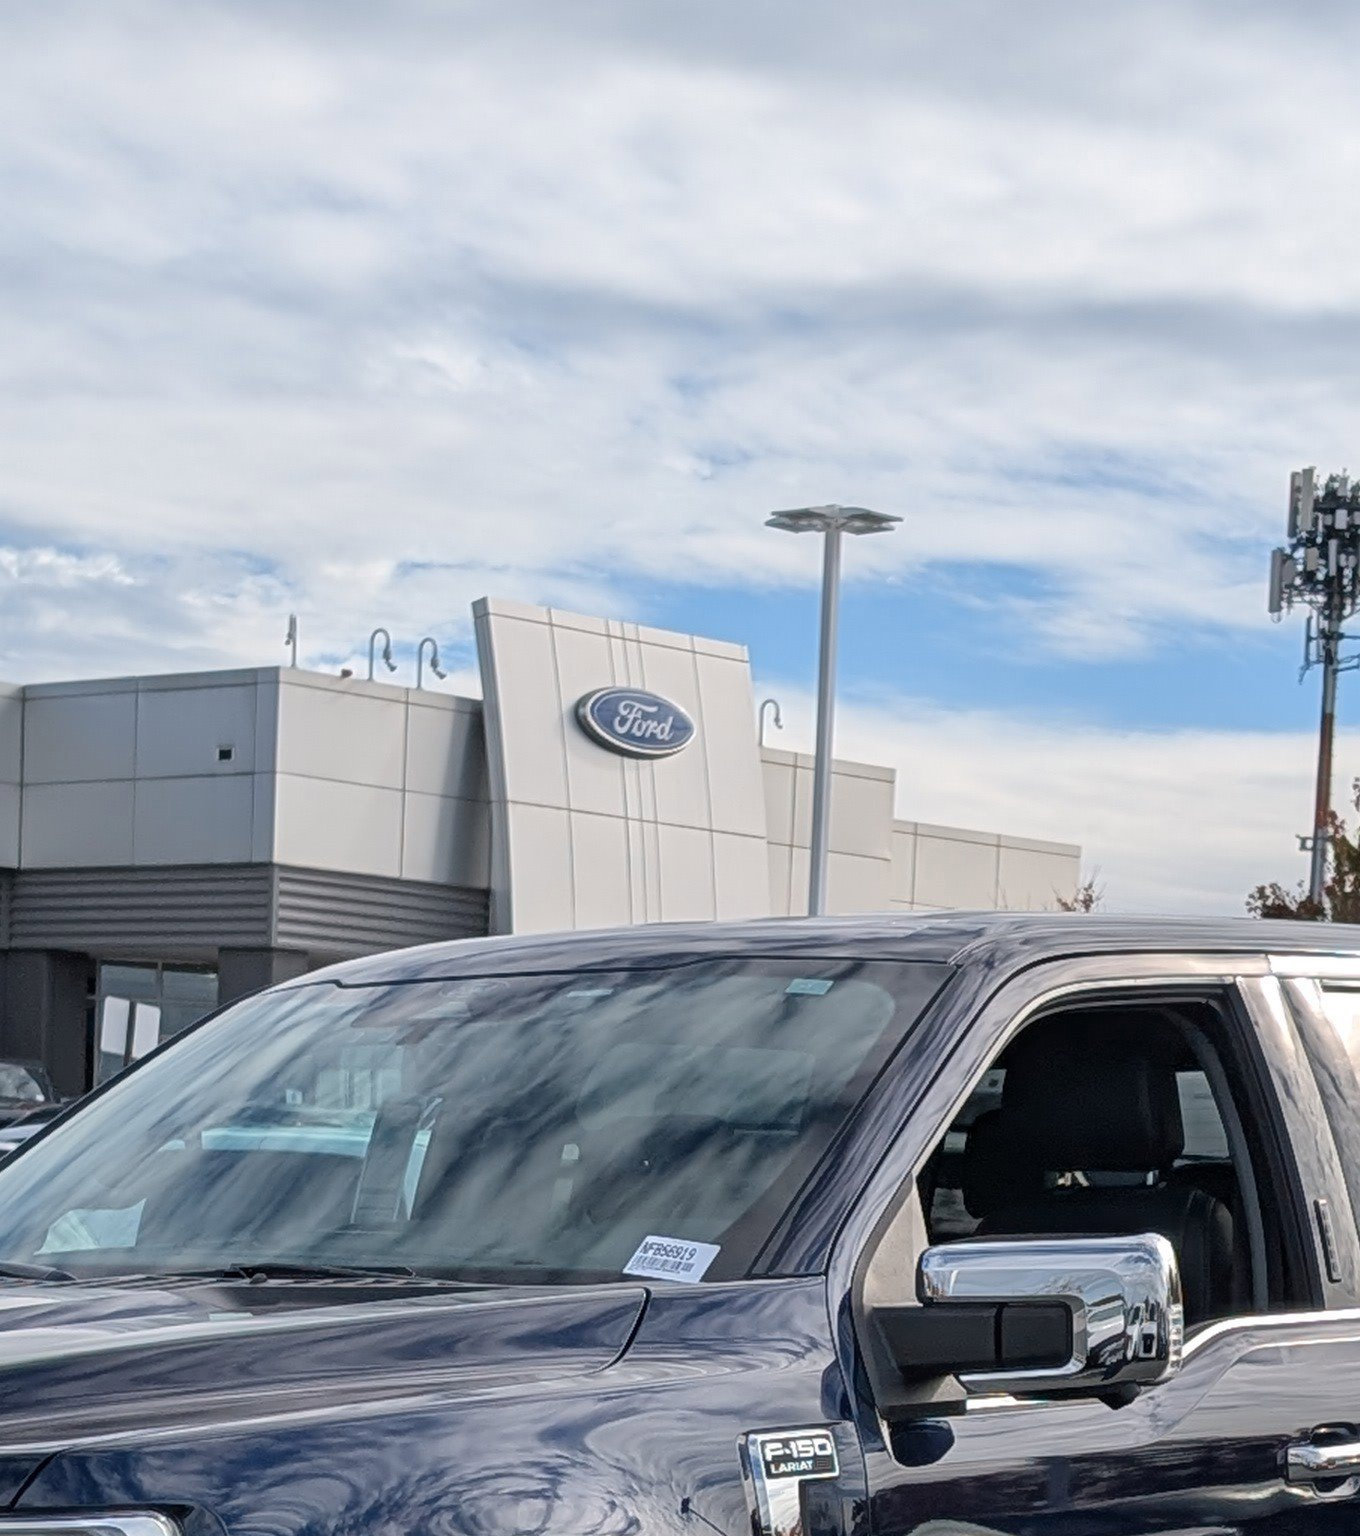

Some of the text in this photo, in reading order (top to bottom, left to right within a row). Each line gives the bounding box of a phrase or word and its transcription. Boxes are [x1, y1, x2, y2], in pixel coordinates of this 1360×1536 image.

[613, 699, 674, 741] Ford
[764, 1438, 832, 1461] F-150
[770, 1460, 813, 1474] LARIAT
